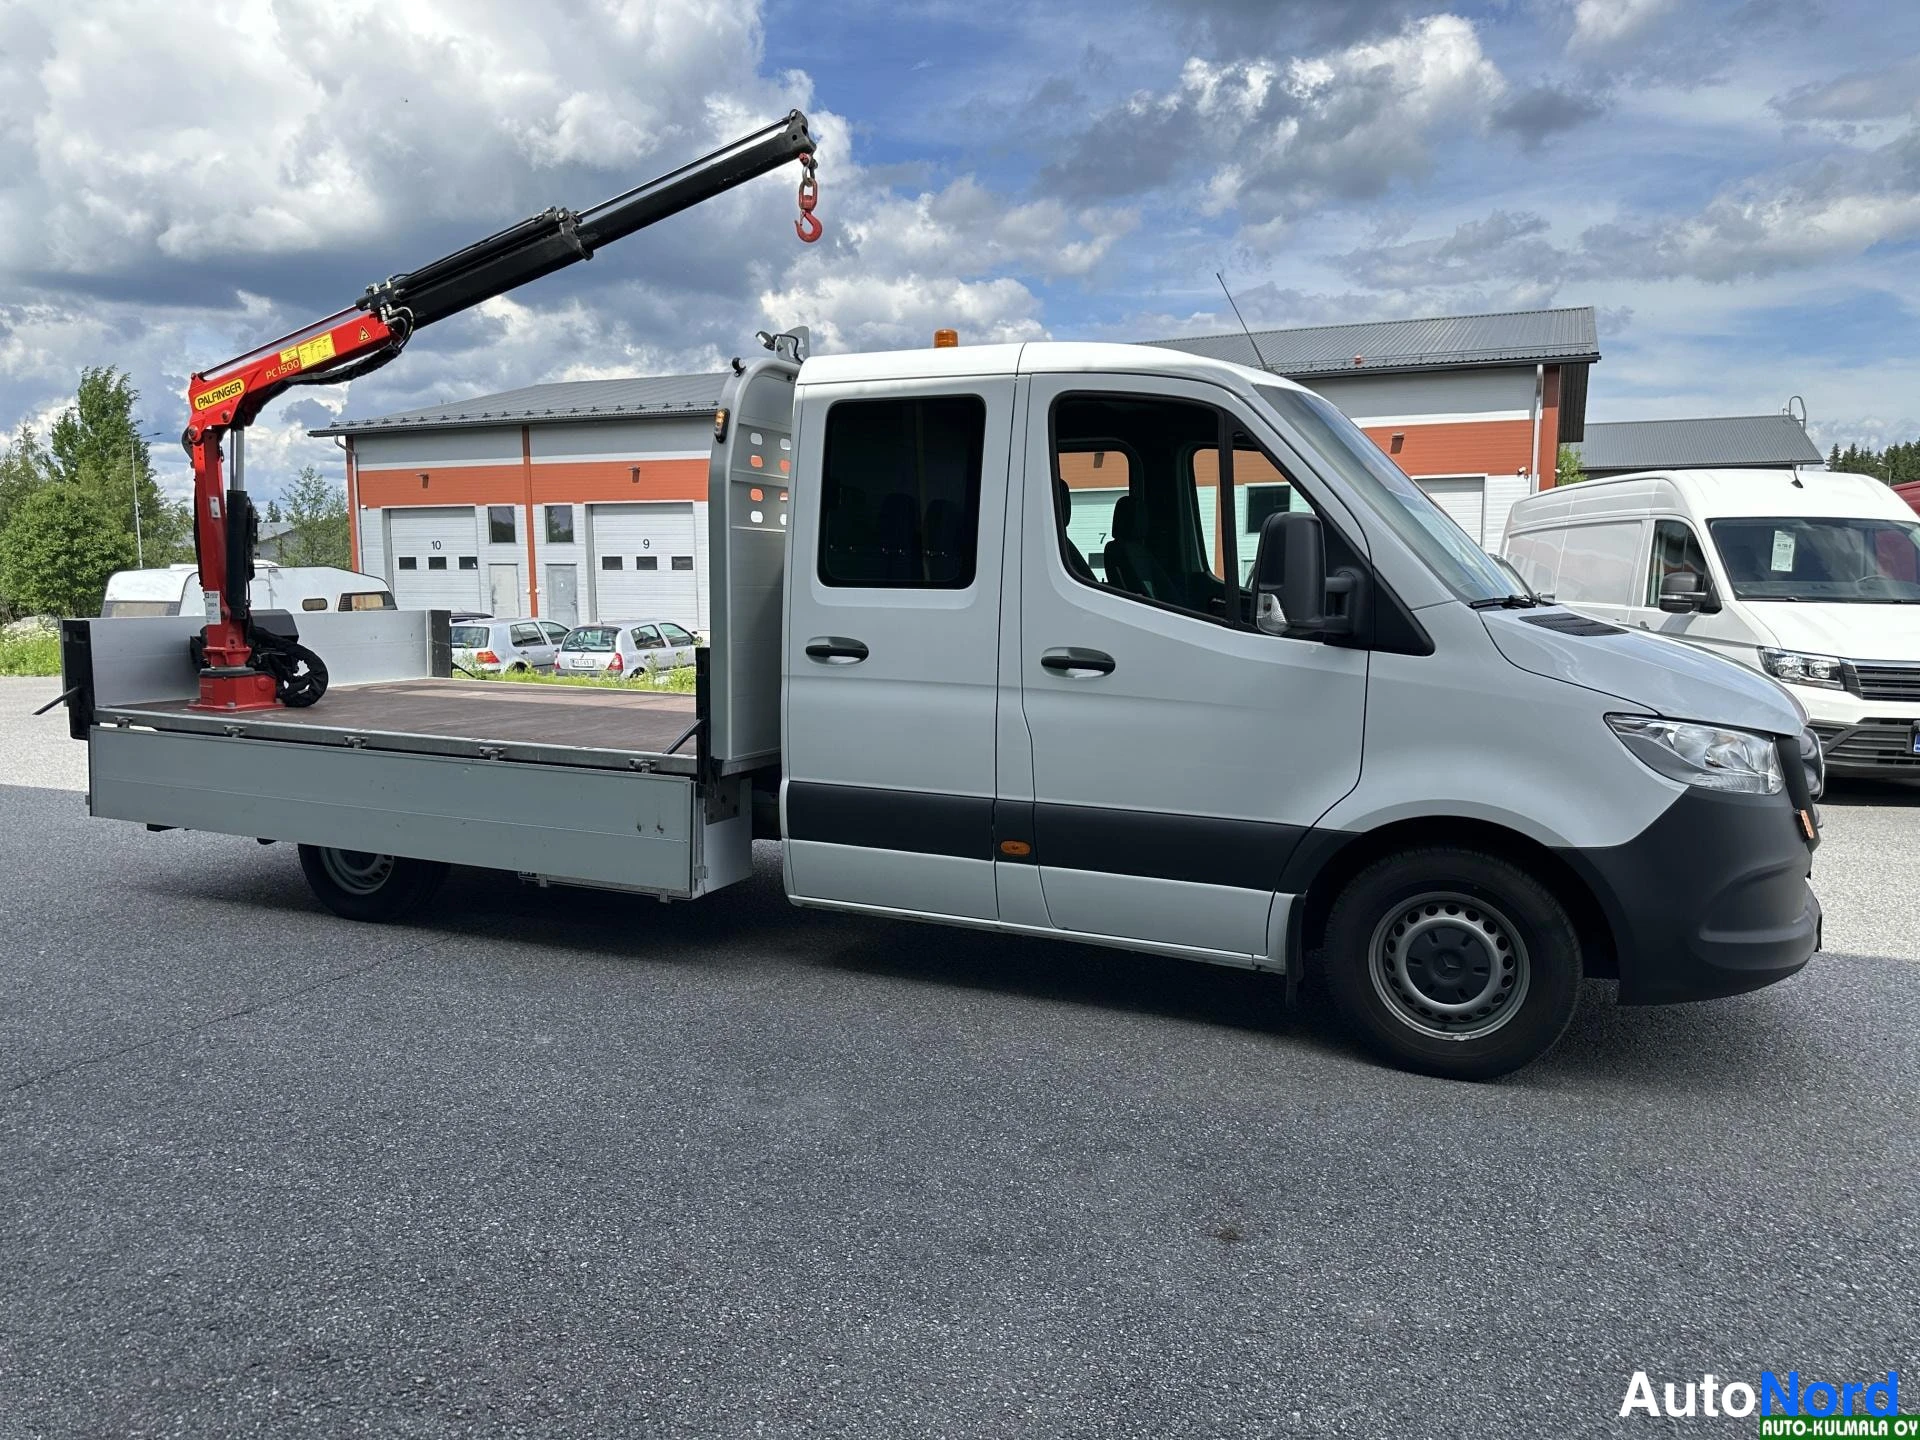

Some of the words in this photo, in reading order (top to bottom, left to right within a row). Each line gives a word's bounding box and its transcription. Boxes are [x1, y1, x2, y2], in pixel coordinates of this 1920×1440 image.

[265, 368, 277, 380] PC
[278, 359, 299, 375] 1500
[197, 381, 242, 408] PALFINGER
[431, 540, 442, 550] 10
[643, 538, 650, 549] 9
[1098, 532, 1107, 545] 7
